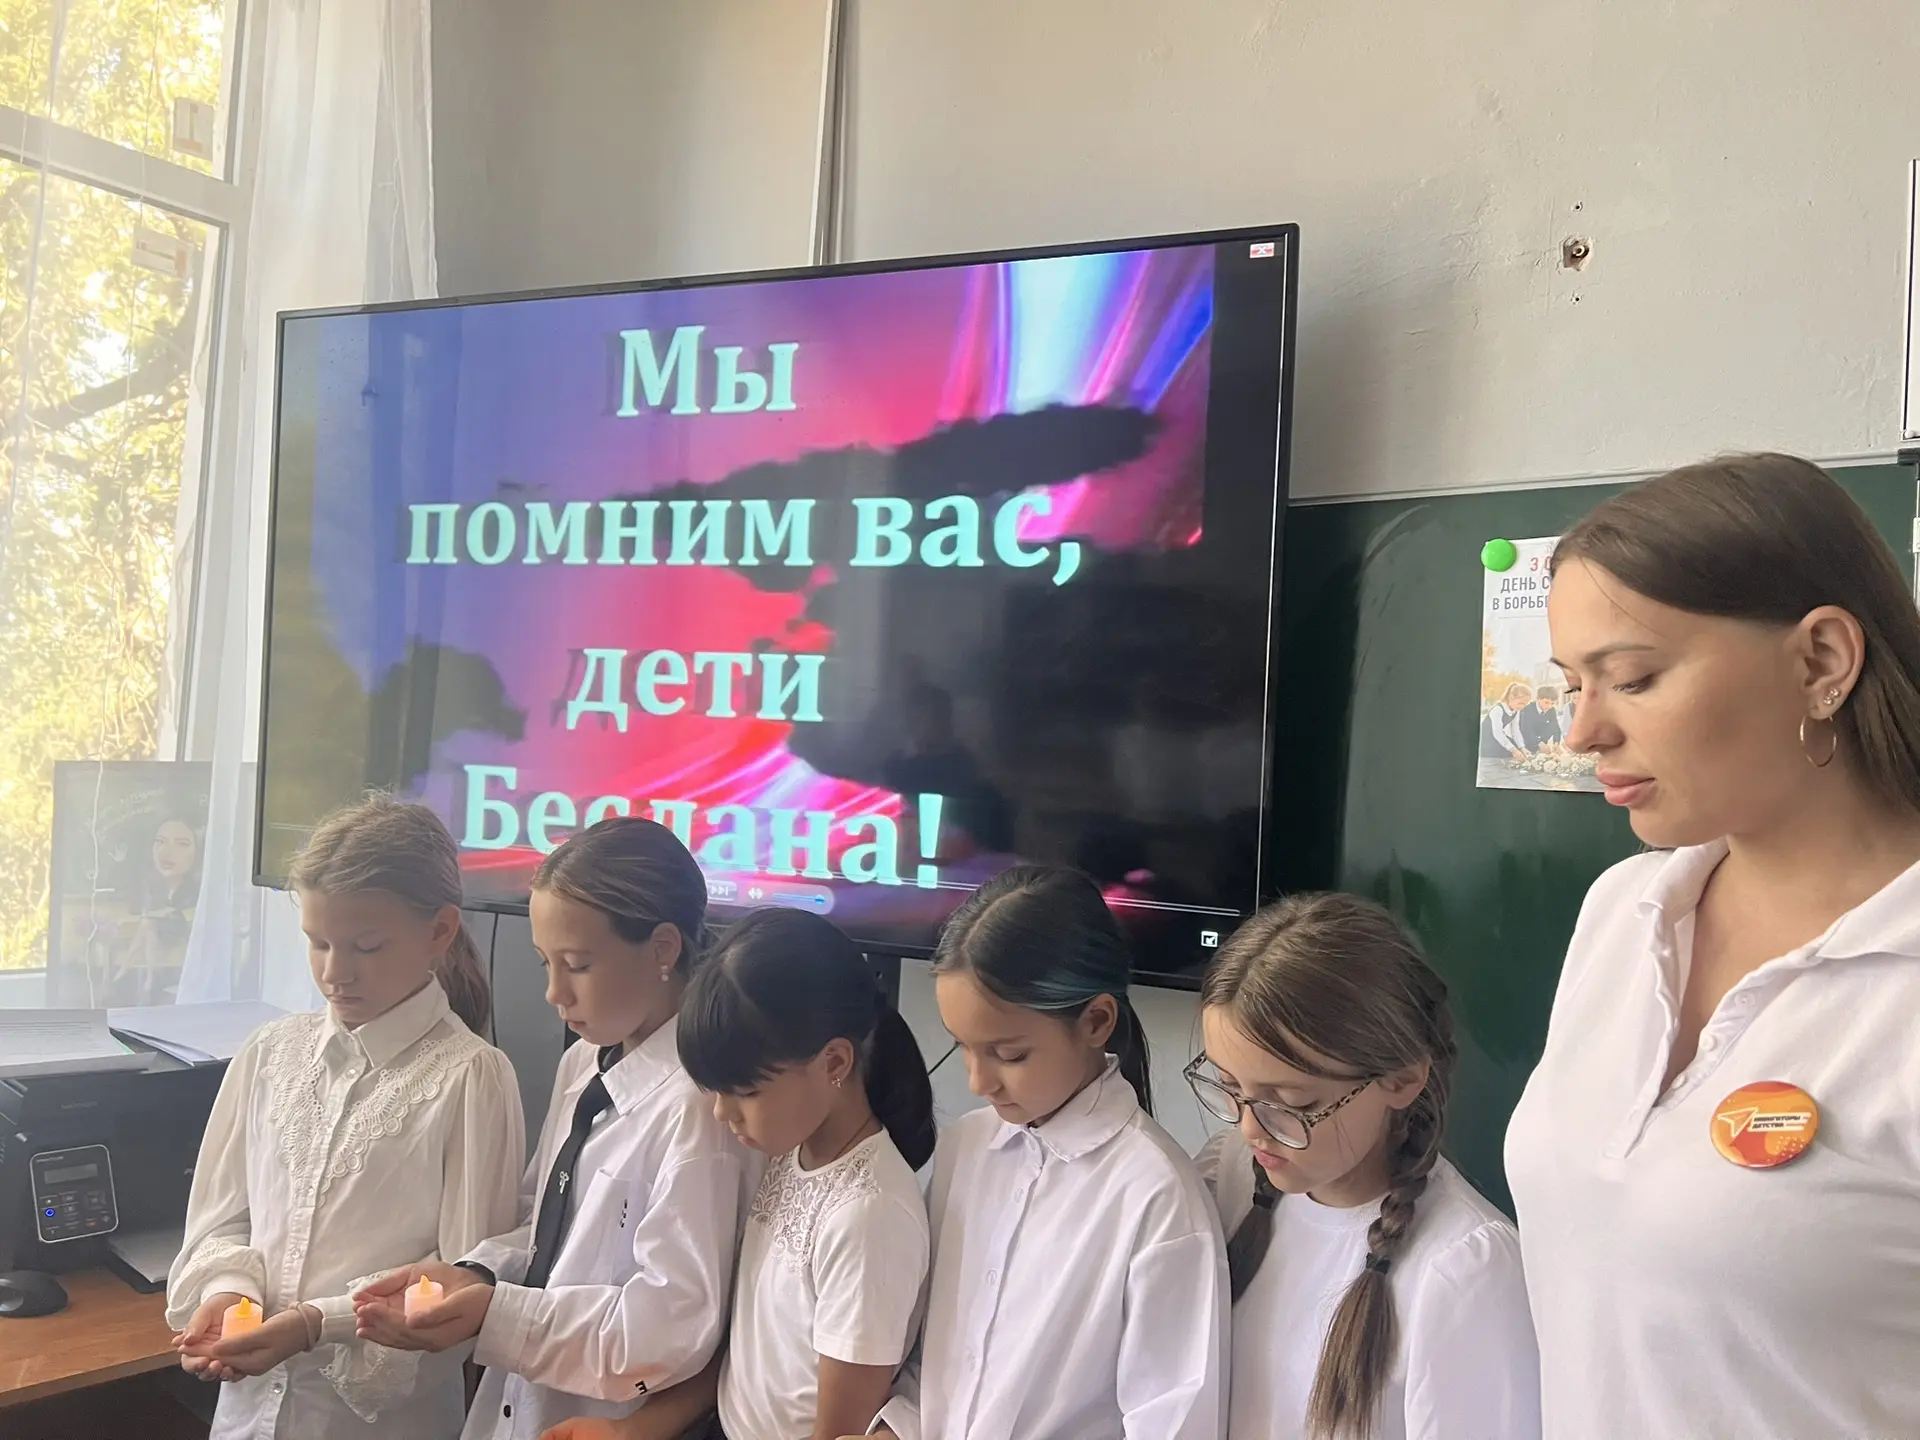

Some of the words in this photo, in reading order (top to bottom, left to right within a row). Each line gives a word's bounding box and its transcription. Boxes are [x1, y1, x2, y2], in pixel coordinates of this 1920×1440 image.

[617, 325, 798, 418] Мы
[406, 498, 816, 567] помним
[849, 493, 1083, 586] вас,
[1492, 597, 1500, 610] В
[1500, 576, 1537, 593] ДЕНЬ
[566, 648, 825, 732] дети
